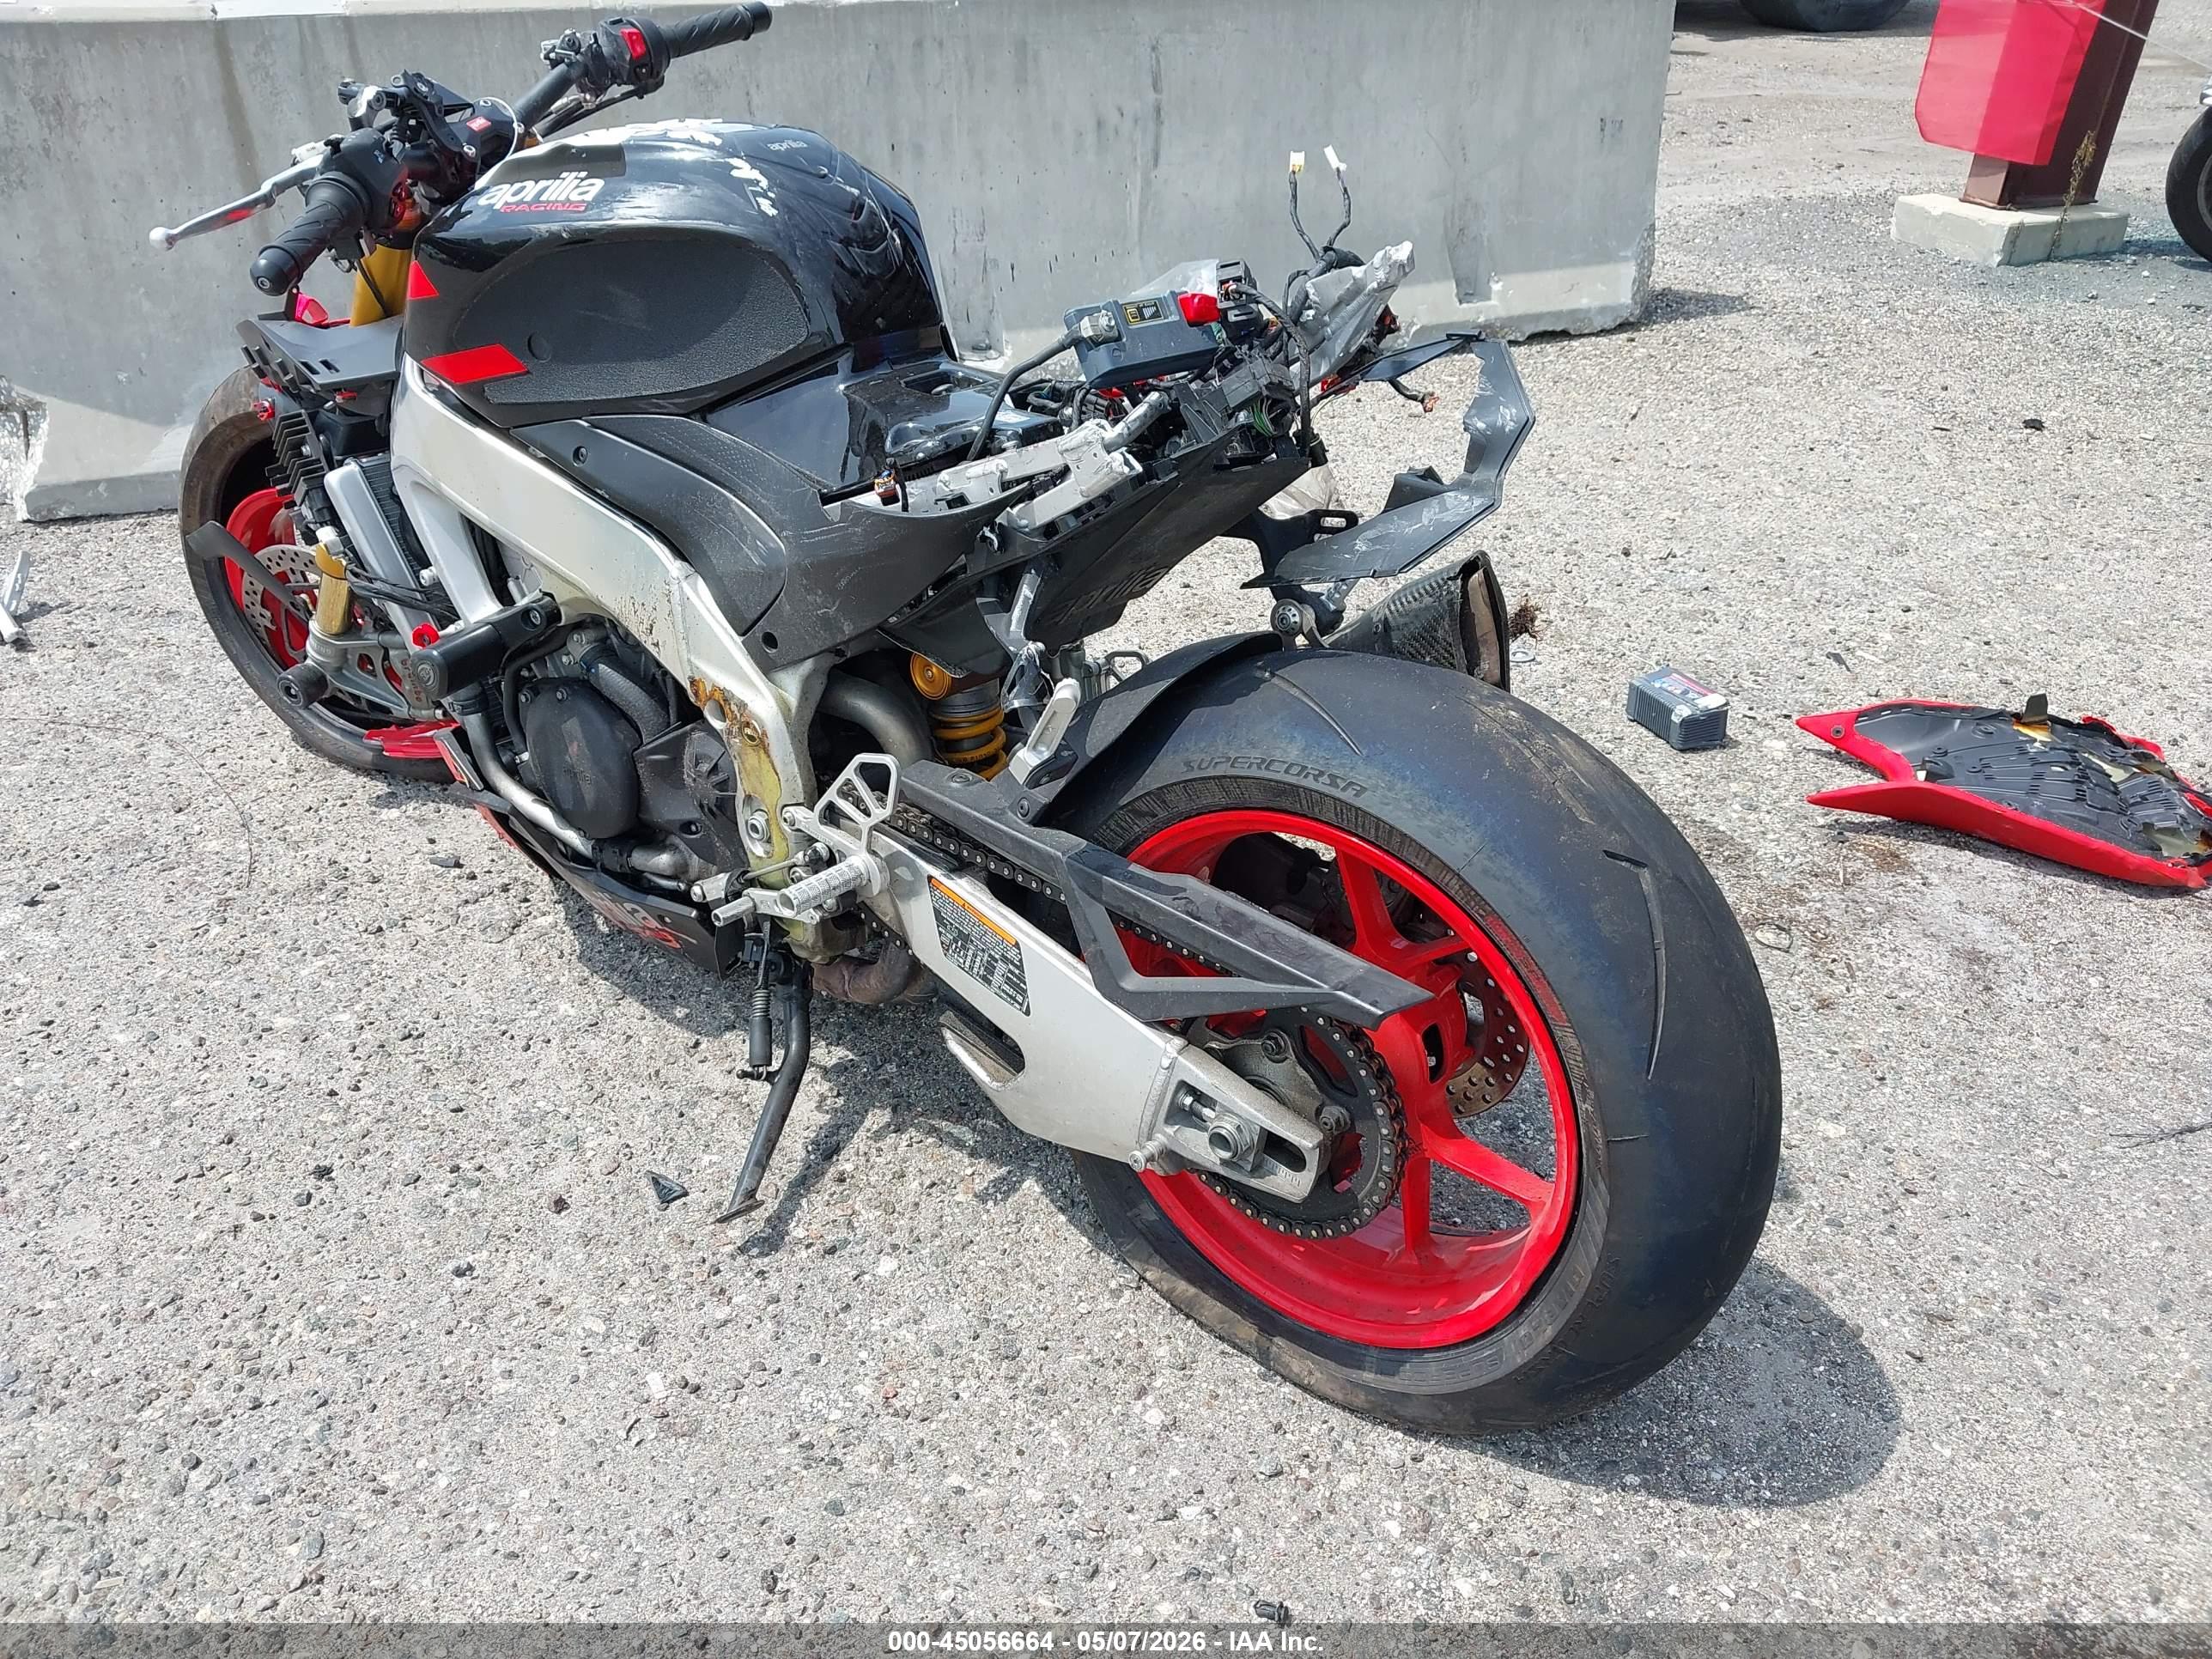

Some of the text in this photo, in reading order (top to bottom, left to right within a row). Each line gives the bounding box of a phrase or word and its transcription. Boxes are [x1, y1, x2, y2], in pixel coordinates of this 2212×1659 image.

[767, 139, 808, 151] aprilia
[477, 171, 605, 210] aprilia
[500, 203, 587, 213] RACING
[1181, 755, 1369, 799] SUPERCORSA
